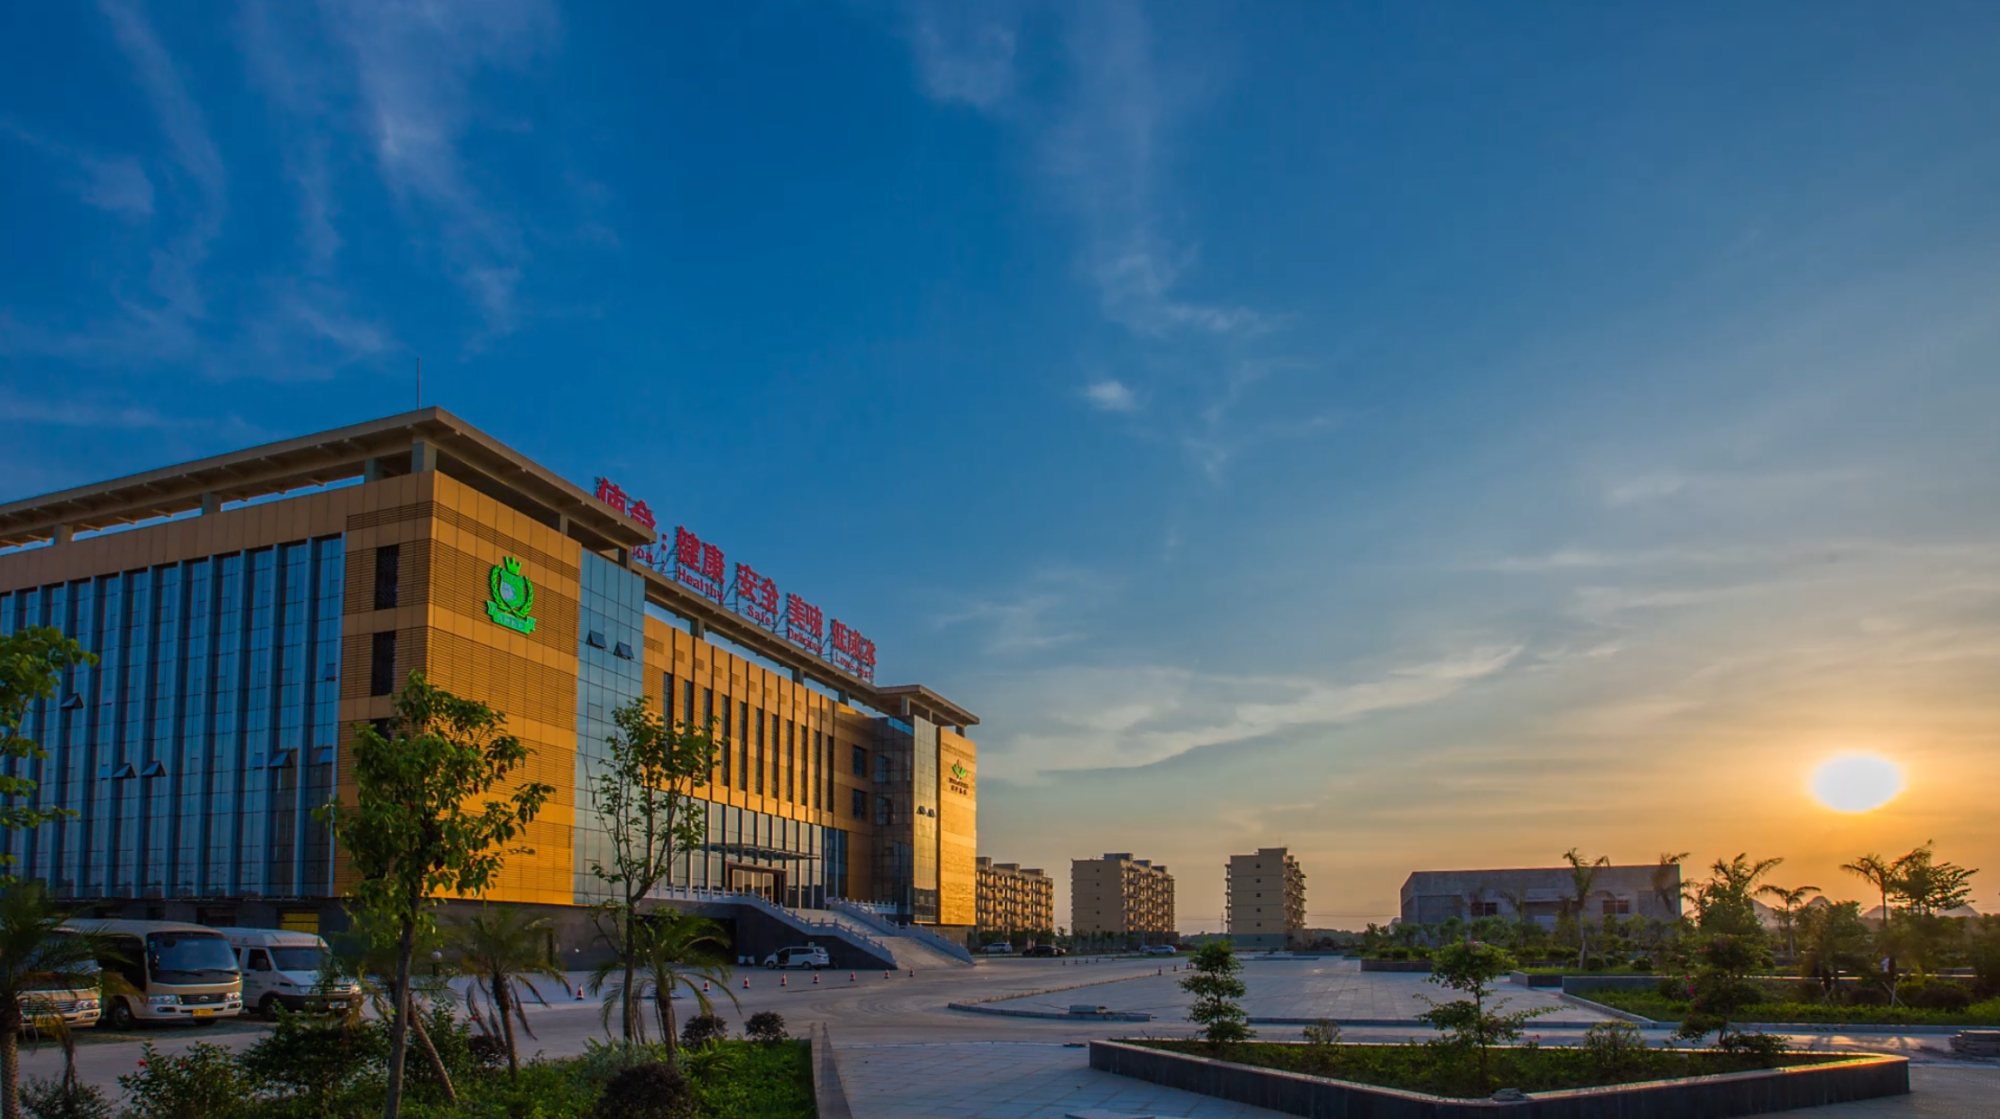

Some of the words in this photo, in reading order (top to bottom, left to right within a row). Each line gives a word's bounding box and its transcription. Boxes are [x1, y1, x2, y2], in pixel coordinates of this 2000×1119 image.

[676, 525, 725, 585] 健康
[737, 563, 779, 615] 安全
[788, 593, 823, 638] 美味
[832, 618, 876, 666] 低成本
[677, 566, 723, 604] Healthy
[747, 604, 771, 626] Safe
